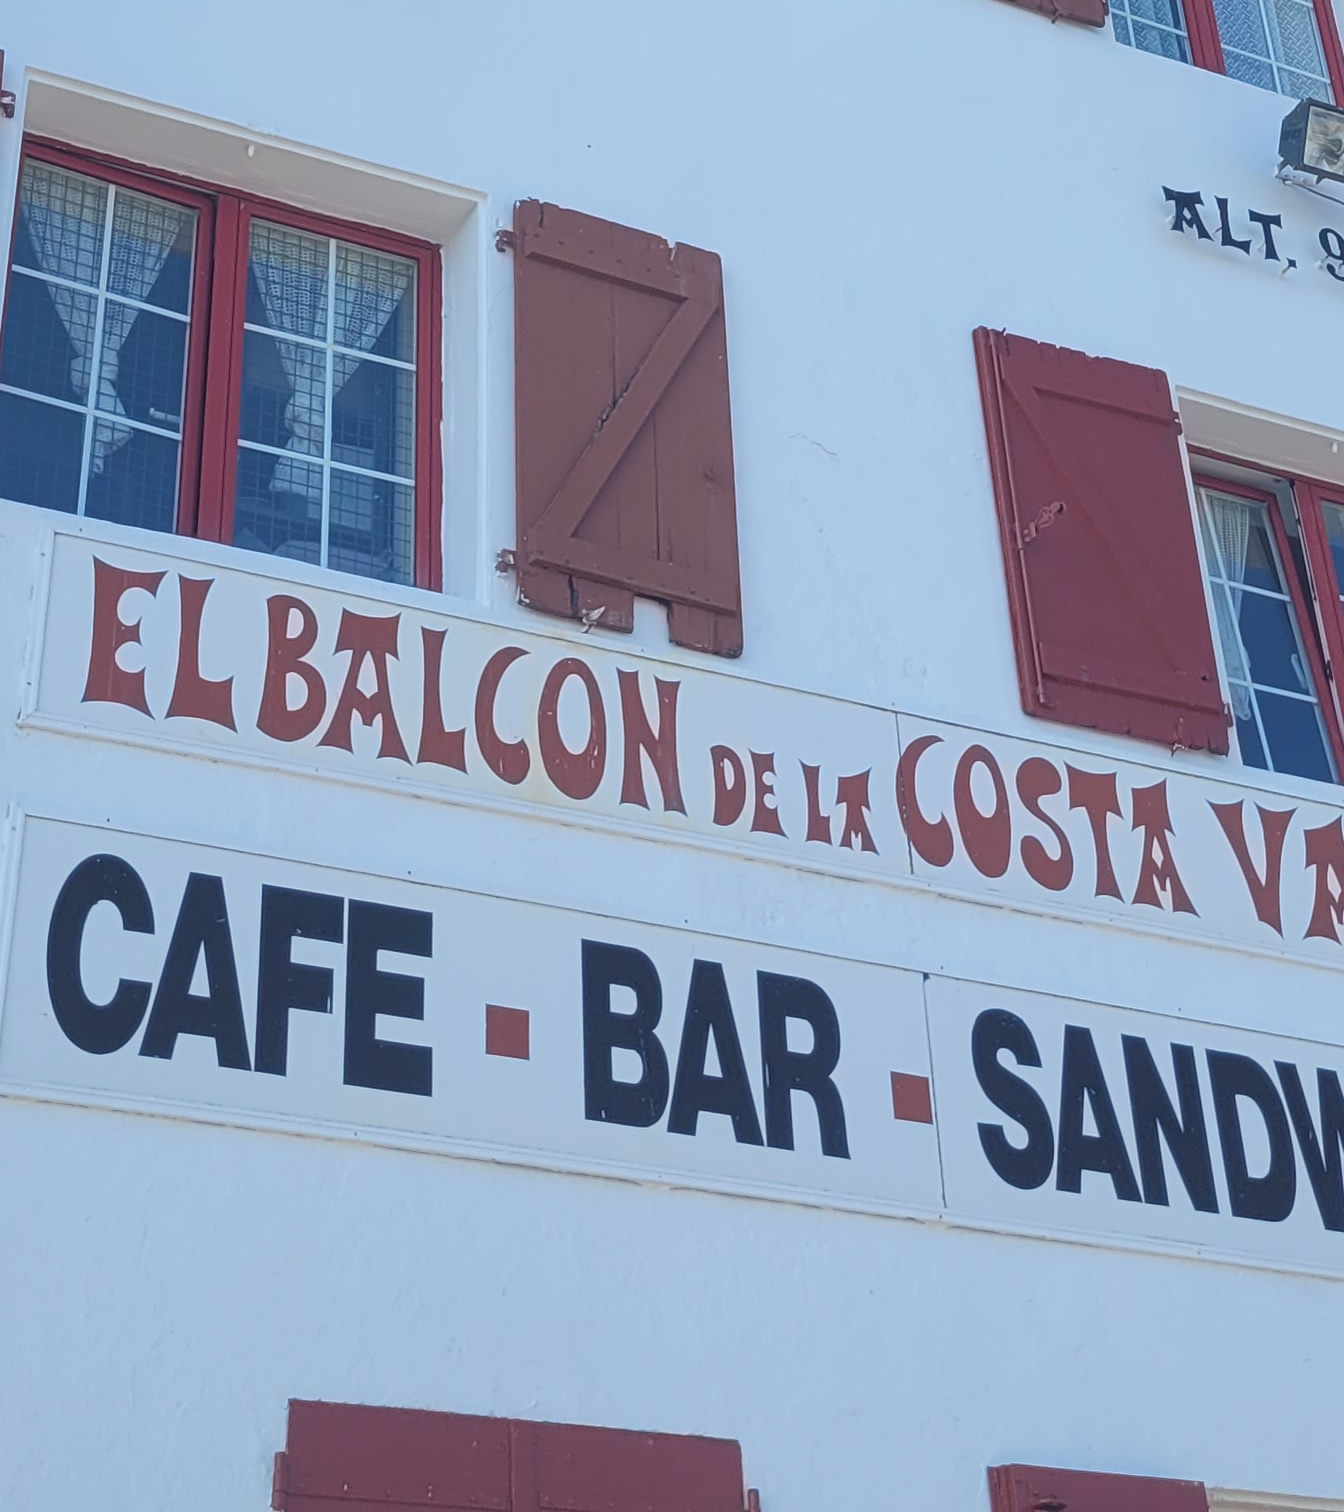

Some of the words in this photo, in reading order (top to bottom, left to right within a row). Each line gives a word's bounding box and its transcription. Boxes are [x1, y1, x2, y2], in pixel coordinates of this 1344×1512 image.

[1161, 185, 1298, 270] ALT.
[81, 555, 238, 734] EL
[256, 593, 688, 817] BALCON
[710, 744, 787, 838] DE
[798, 758, 880, 856] LA
[896, 734, 1201, 918] COSTA
[46, 852, 434, 1098] CAFE
[580, 938, 851, 1160] BAR
